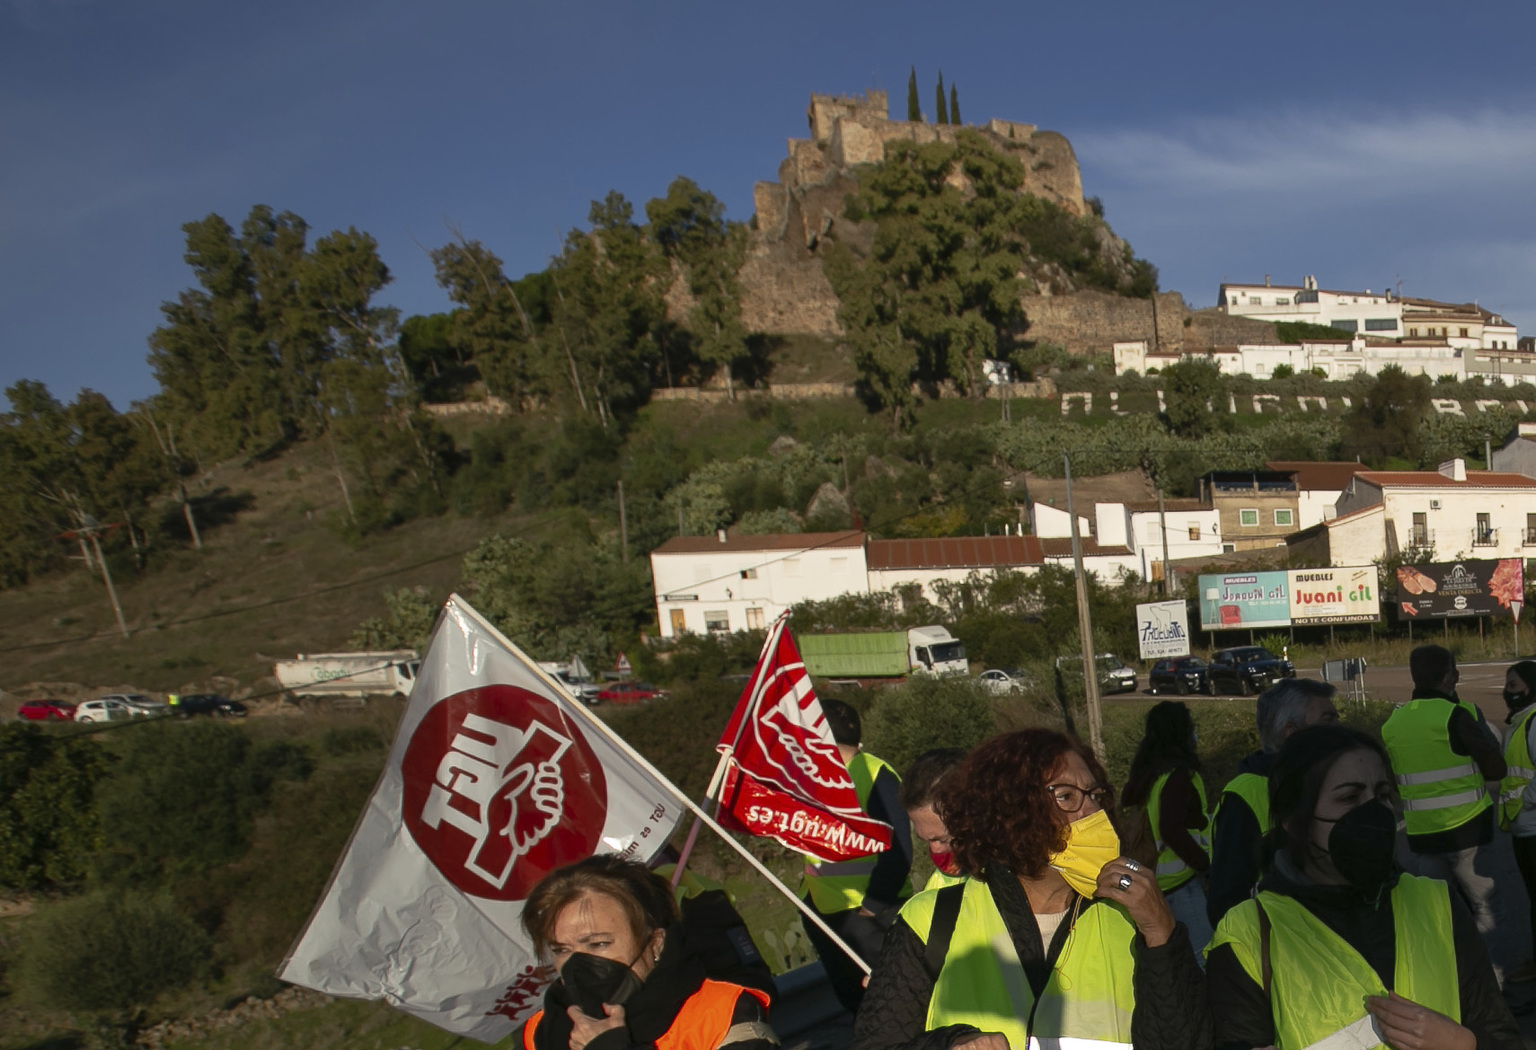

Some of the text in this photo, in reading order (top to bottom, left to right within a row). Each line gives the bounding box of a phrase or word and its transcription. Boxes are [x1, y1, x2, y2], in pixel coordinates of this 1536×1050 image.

[1296, 573, 1333, 582] MUEBLES
[1296, 585, 1342, 604] Juani
[1321, 615, 1374, 623] CONFUNDAS
[747, 804, 884, 853] www.ugt.es
